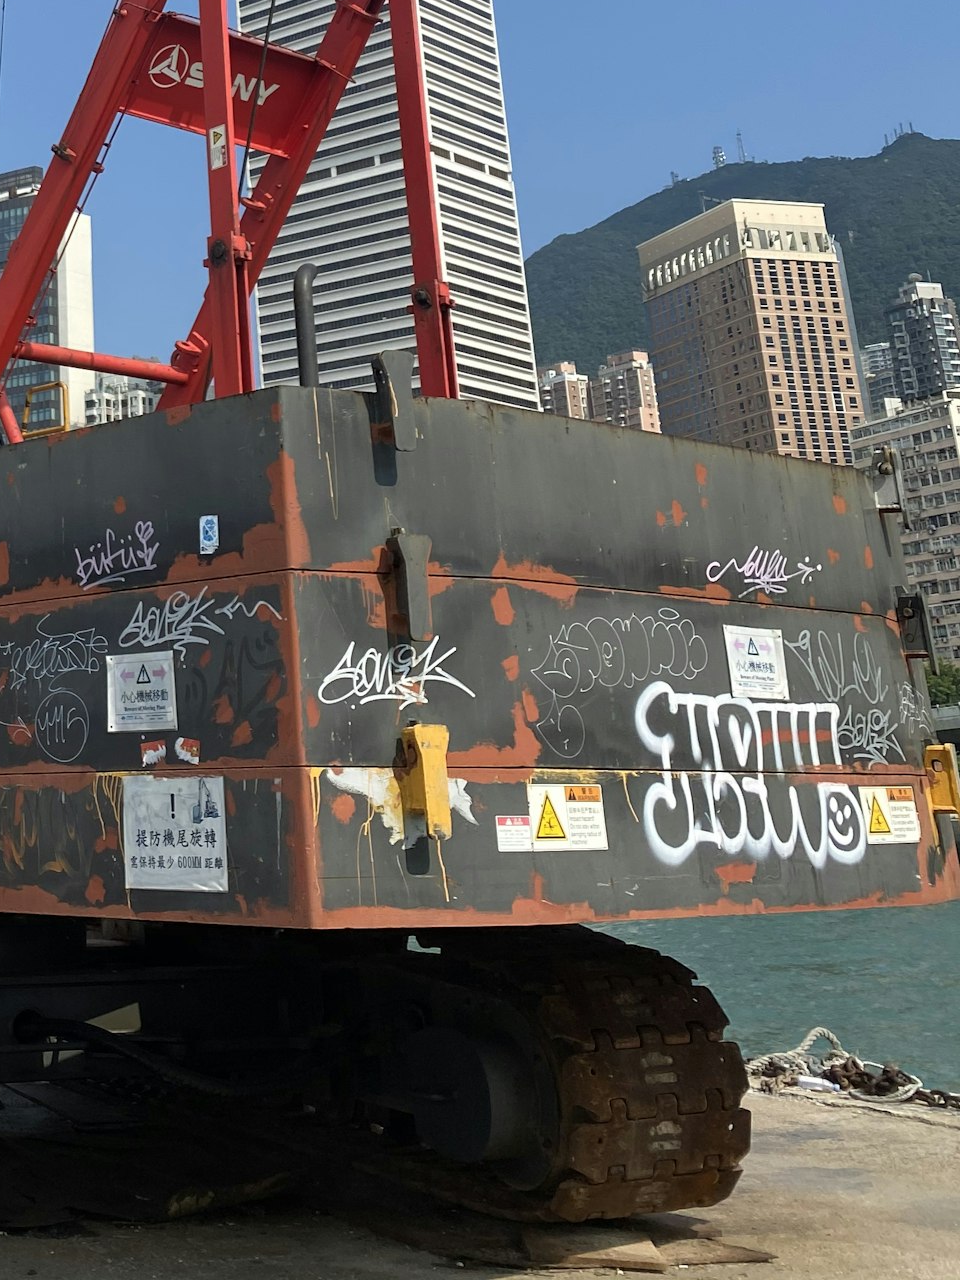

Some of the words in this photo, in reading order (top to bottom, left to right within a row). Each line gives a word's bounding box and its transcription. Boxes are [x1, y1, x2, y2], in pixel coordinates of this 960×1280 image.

[184, 61, 280, 106] SNY
[120, 689, 169, 704] 小心機械移動
[135, 828, 218, 848] 提防機尾旋轉
[177, 856, 202, 869] 600MM
[204, 857, 224, 870] 距離
